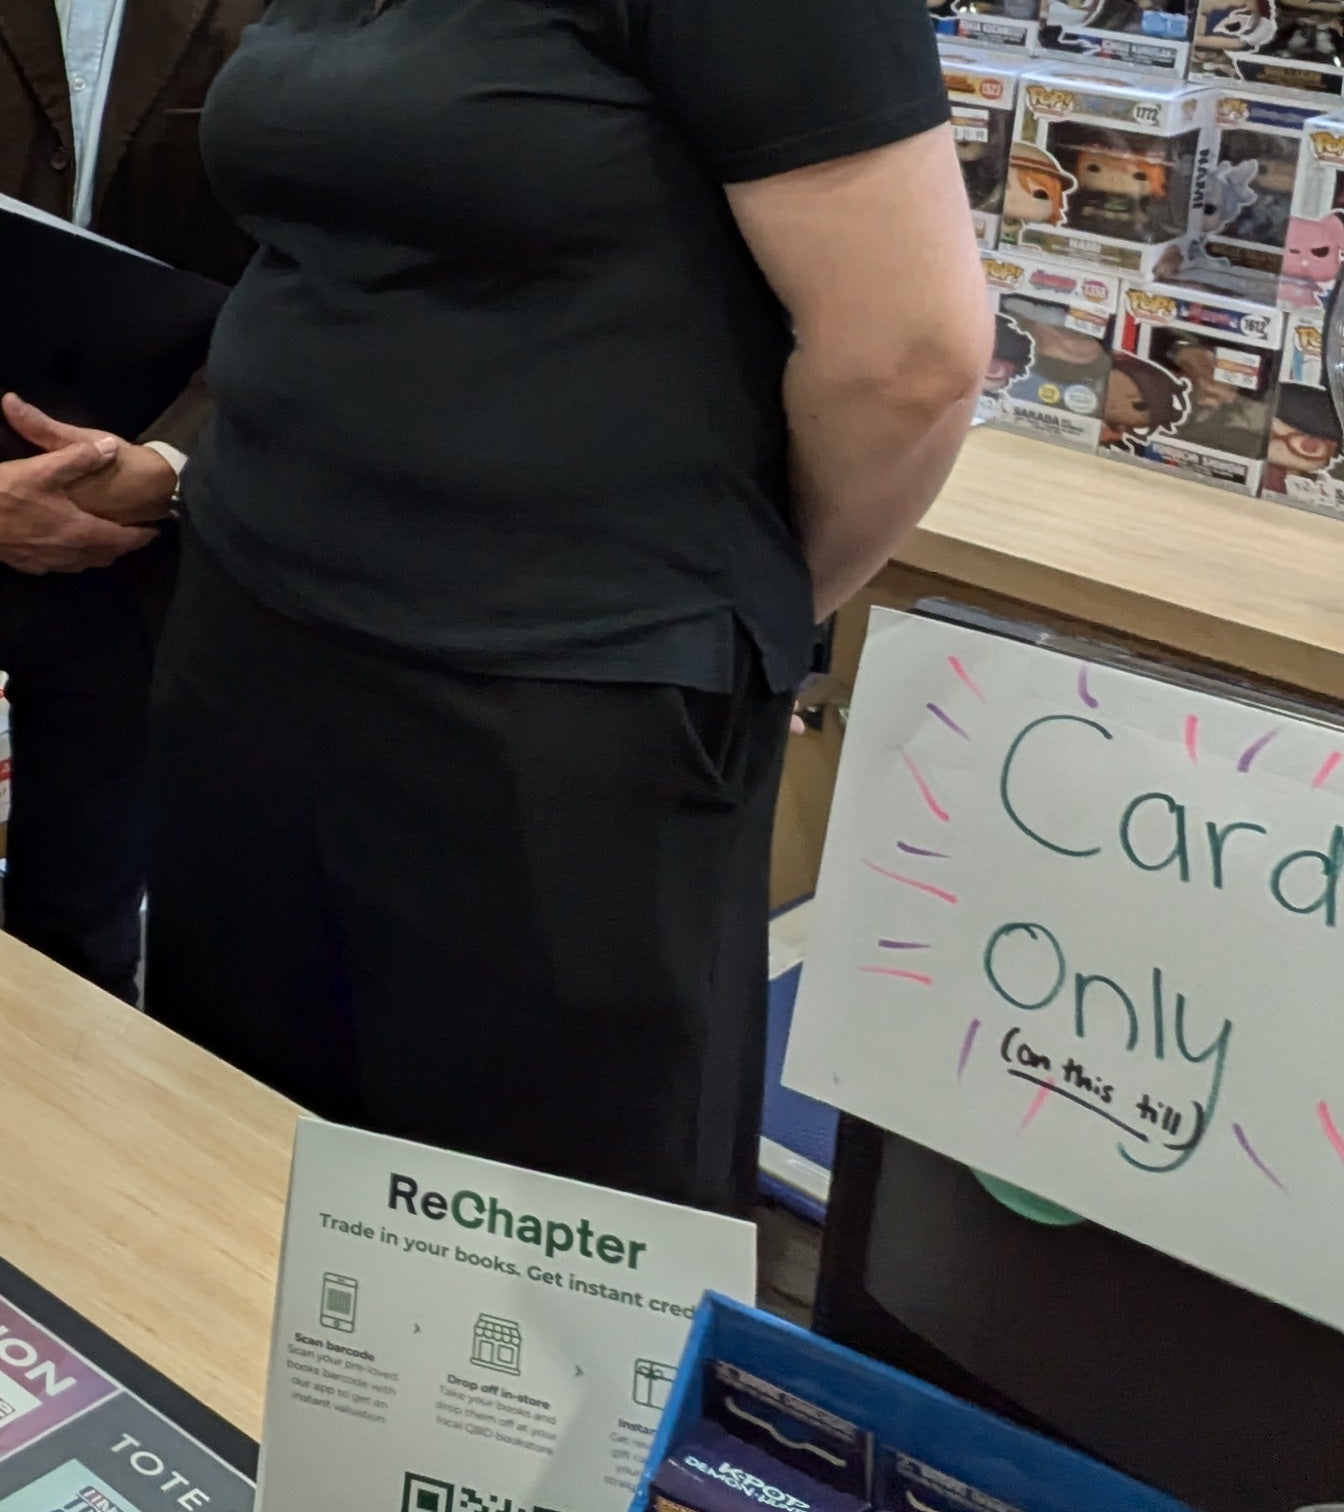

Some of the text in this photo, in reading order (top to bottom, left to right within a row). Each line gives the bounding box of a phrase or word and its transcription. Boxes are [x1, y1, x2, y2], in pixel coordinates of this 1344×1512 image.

[1001, 714, 1344, 928] Card
[983, 921, 1232, 1173] Only
[1062, 1050, 1114, 1104] this
[318, 1212, 376, 1242] Trade
[379, 1226, 400, 1246] in
[403, 1232, 451, 1261] your
[454, 1244, 522, 1278] books.
[526, 1264, 564, 1288] Get
[567, 1271, 644, 1308] instant
[386, 1172, 648, 1271] ReChapter
[288, 1343, 315, 1359] Scan
[295, 1332, 376, 1362] Scan barcode
[448, 1374, 551, 1411] Drop off in-store
[111, 1433, 210, 1511] TOTE
